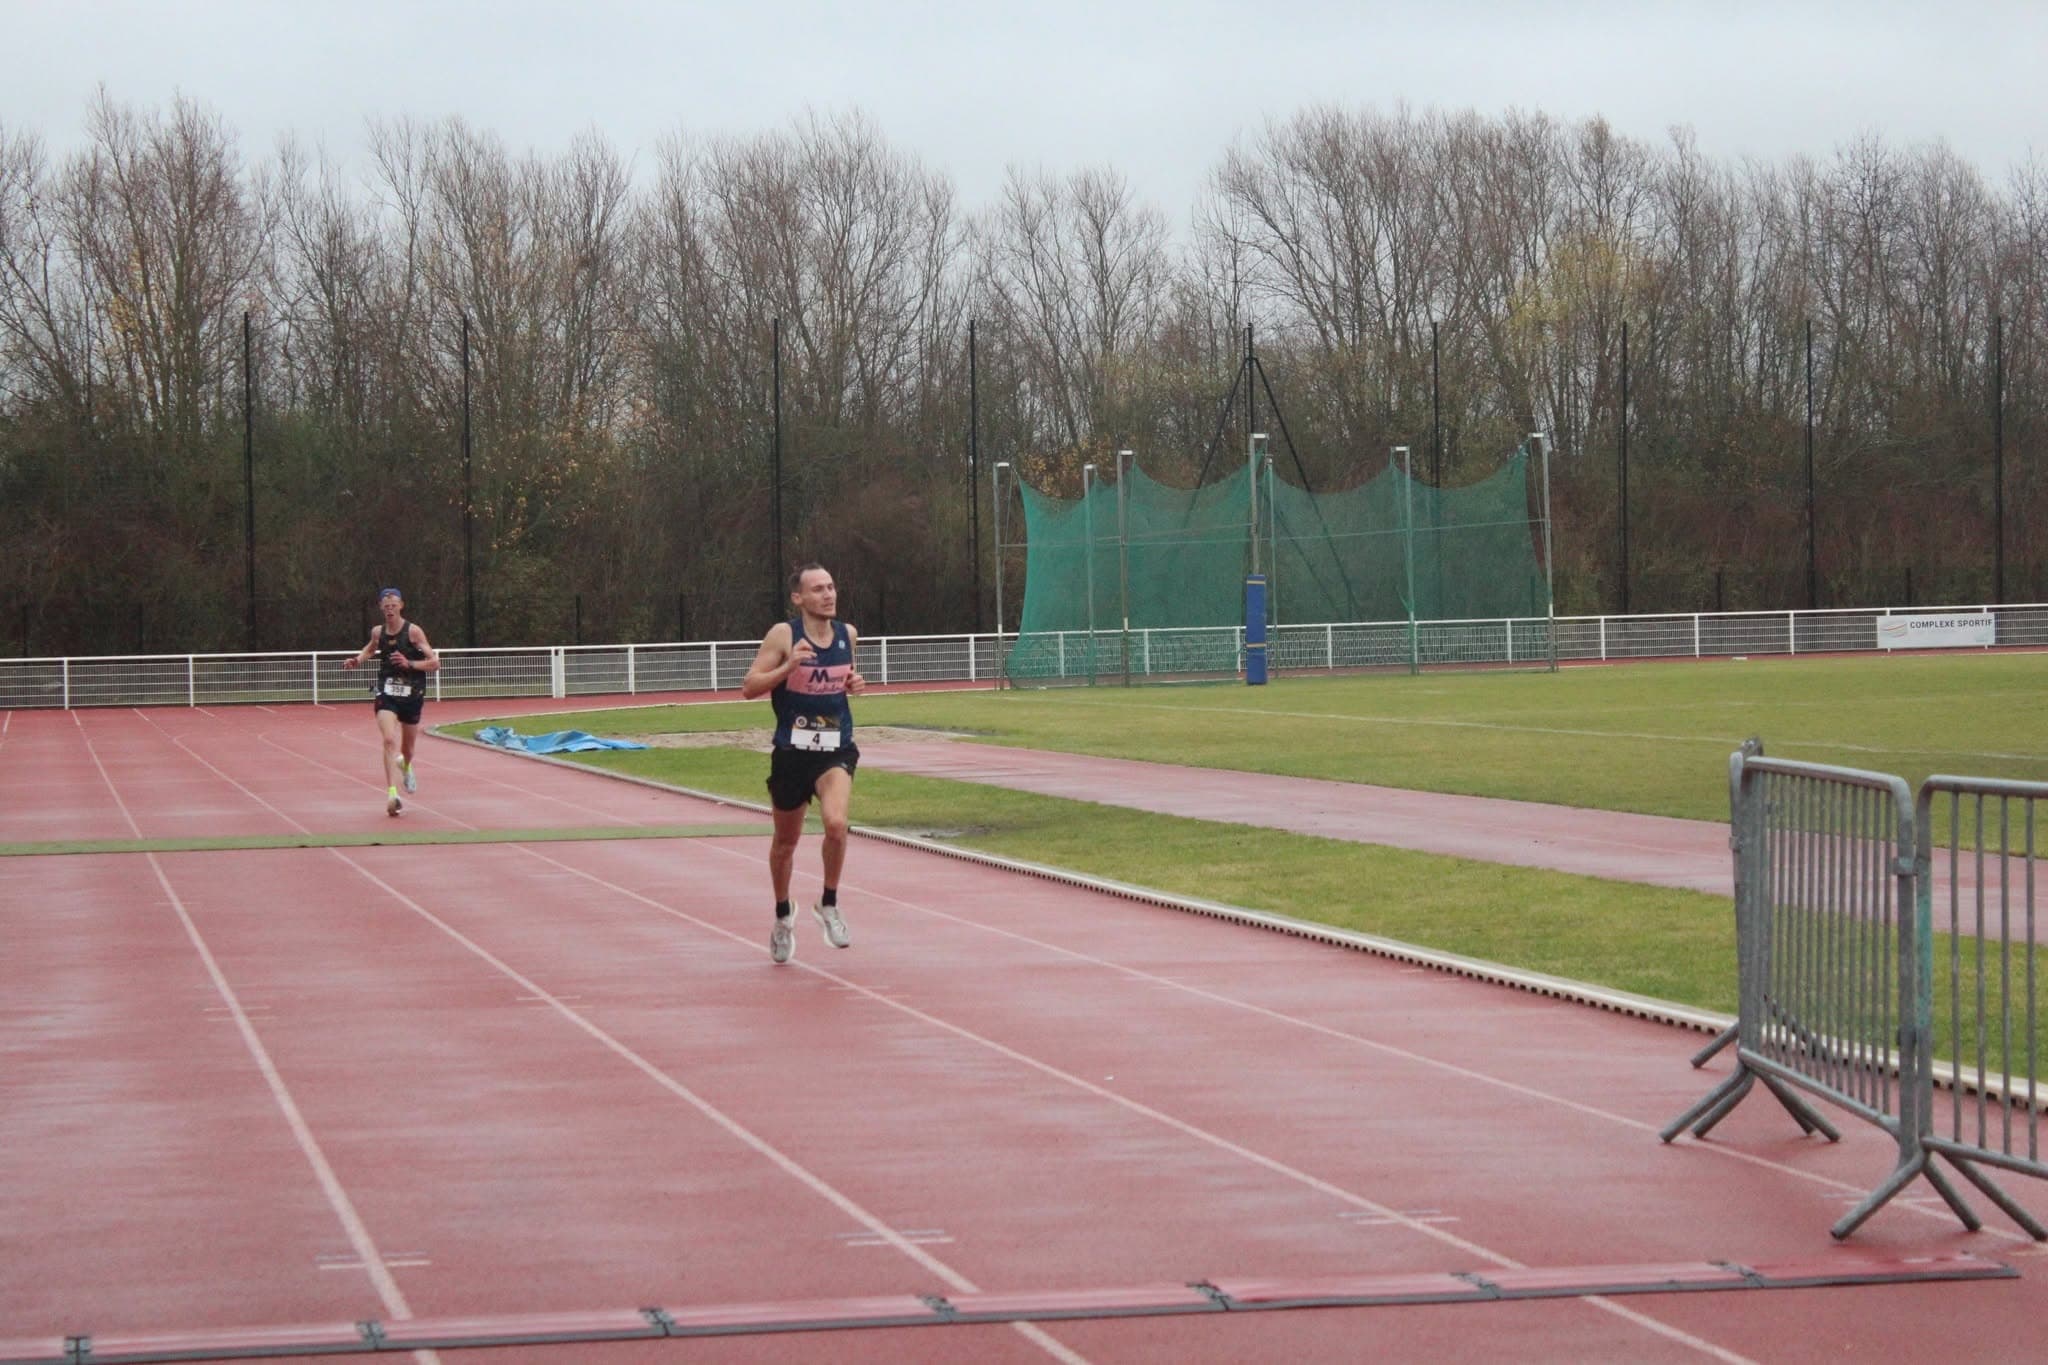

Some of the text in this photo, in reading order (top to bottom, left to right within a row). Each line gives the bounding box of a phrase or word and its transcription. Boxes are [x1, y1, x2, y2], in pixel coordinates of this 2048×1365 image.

[1910, 619, 1993, 629] COMPLEXE SPORTIF
[812, 733, 820, 745] 4
